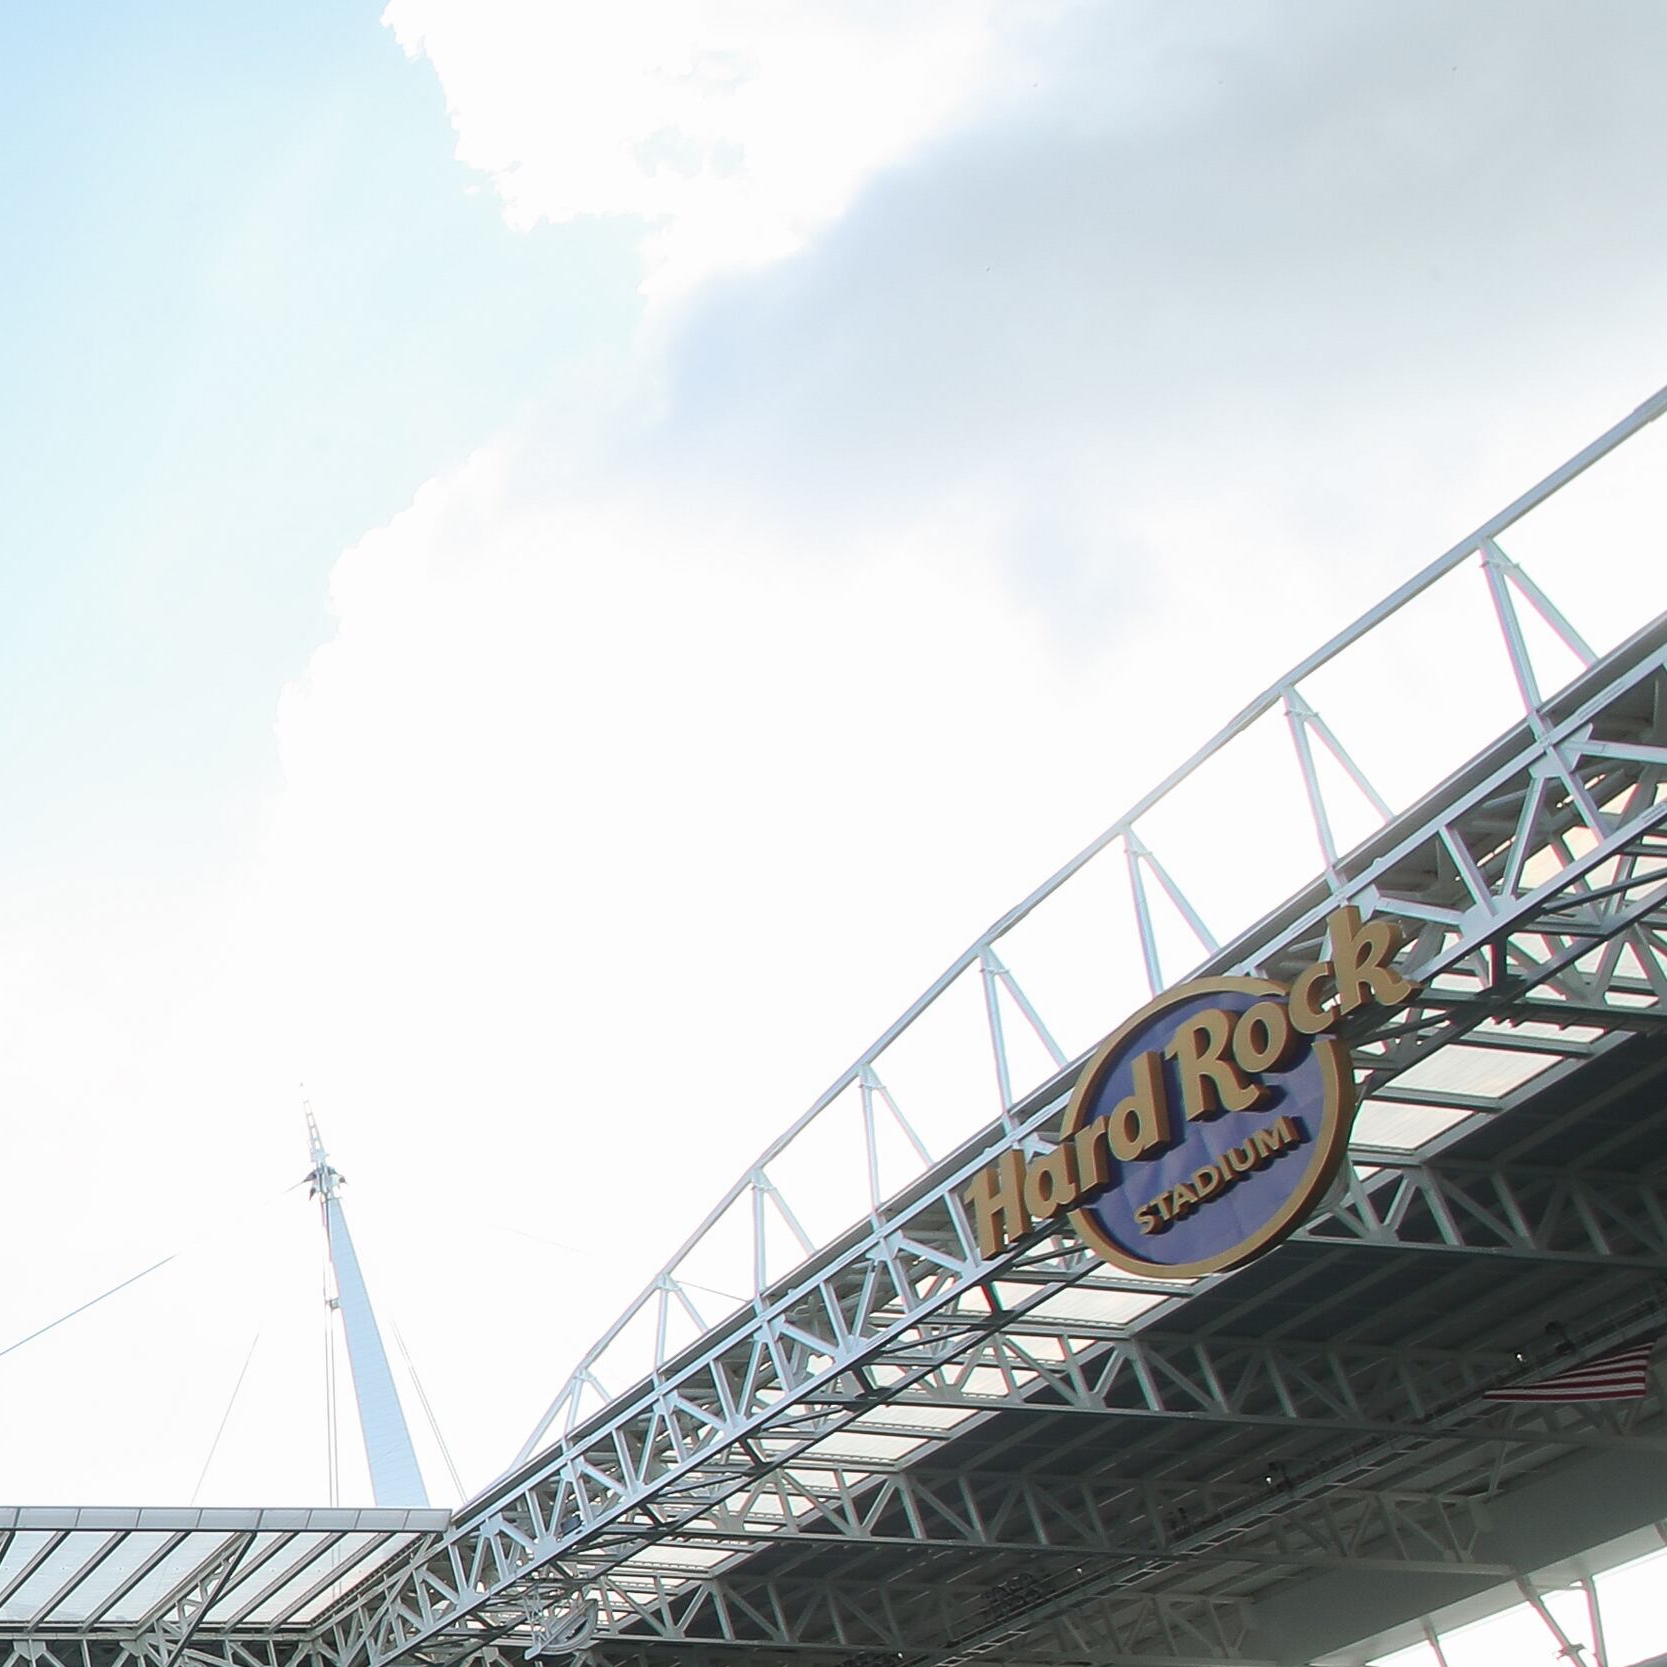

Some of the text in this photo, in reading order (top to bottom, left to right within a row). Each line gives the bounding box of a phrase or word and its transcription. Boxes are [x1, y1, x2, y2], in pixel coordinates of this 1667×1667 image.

[964, 906, 1421, 1260] Hard Rock
[1134, 1115, 1309, 1236] STADIUM
